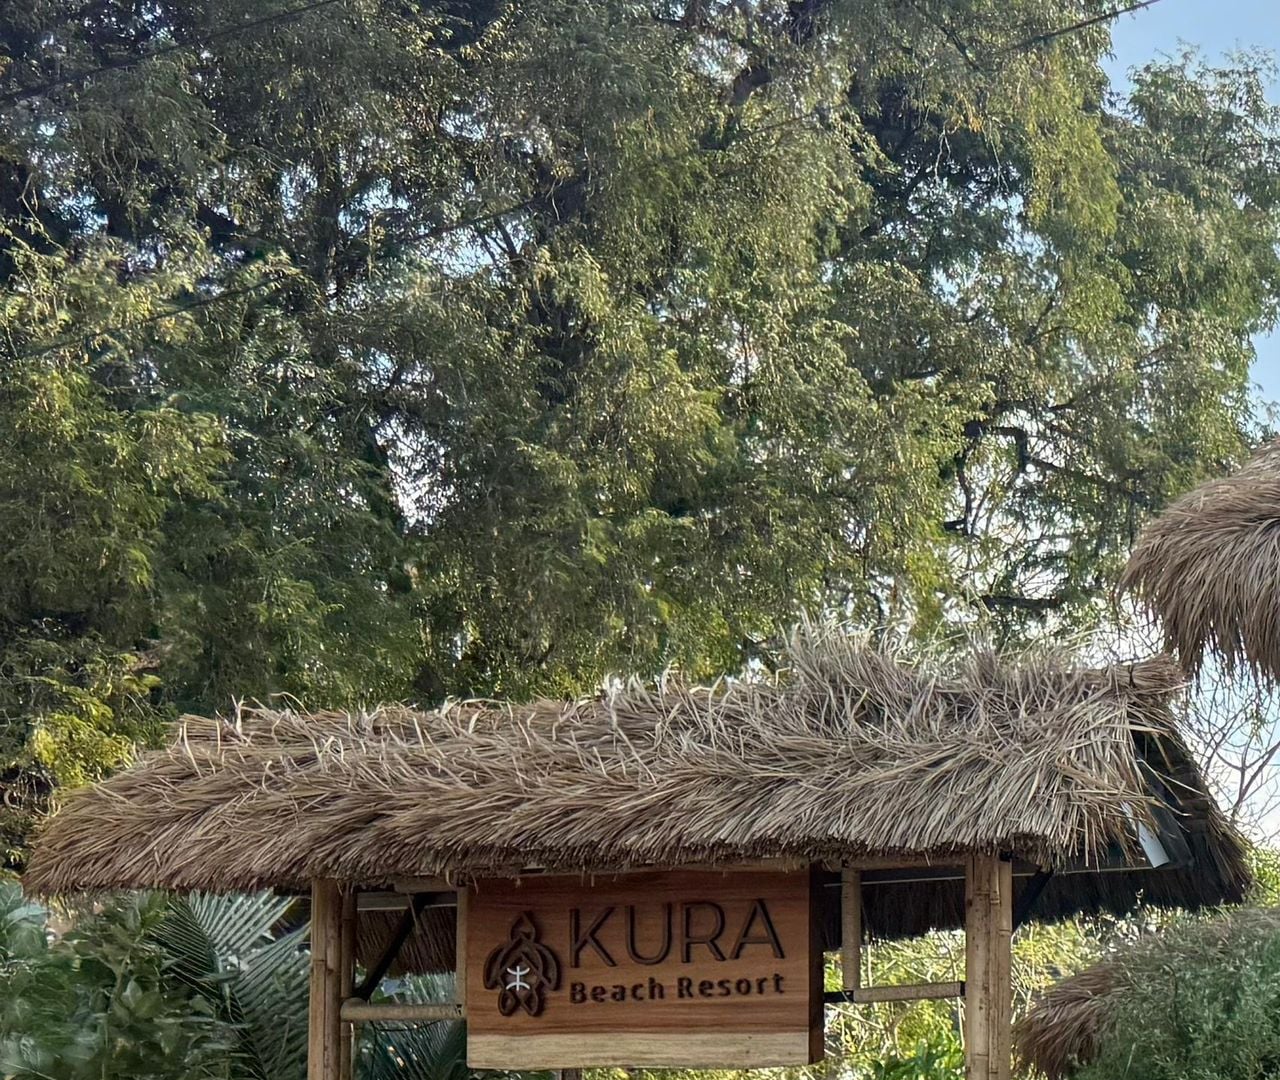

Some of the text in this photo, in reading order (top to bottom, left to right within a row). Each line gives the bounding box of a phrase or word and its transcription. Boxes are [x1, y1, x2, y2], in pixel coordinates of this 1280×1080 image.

[569, 898, 786, 968] KURA
[569, 972, 786, 1004] Beach Resort
